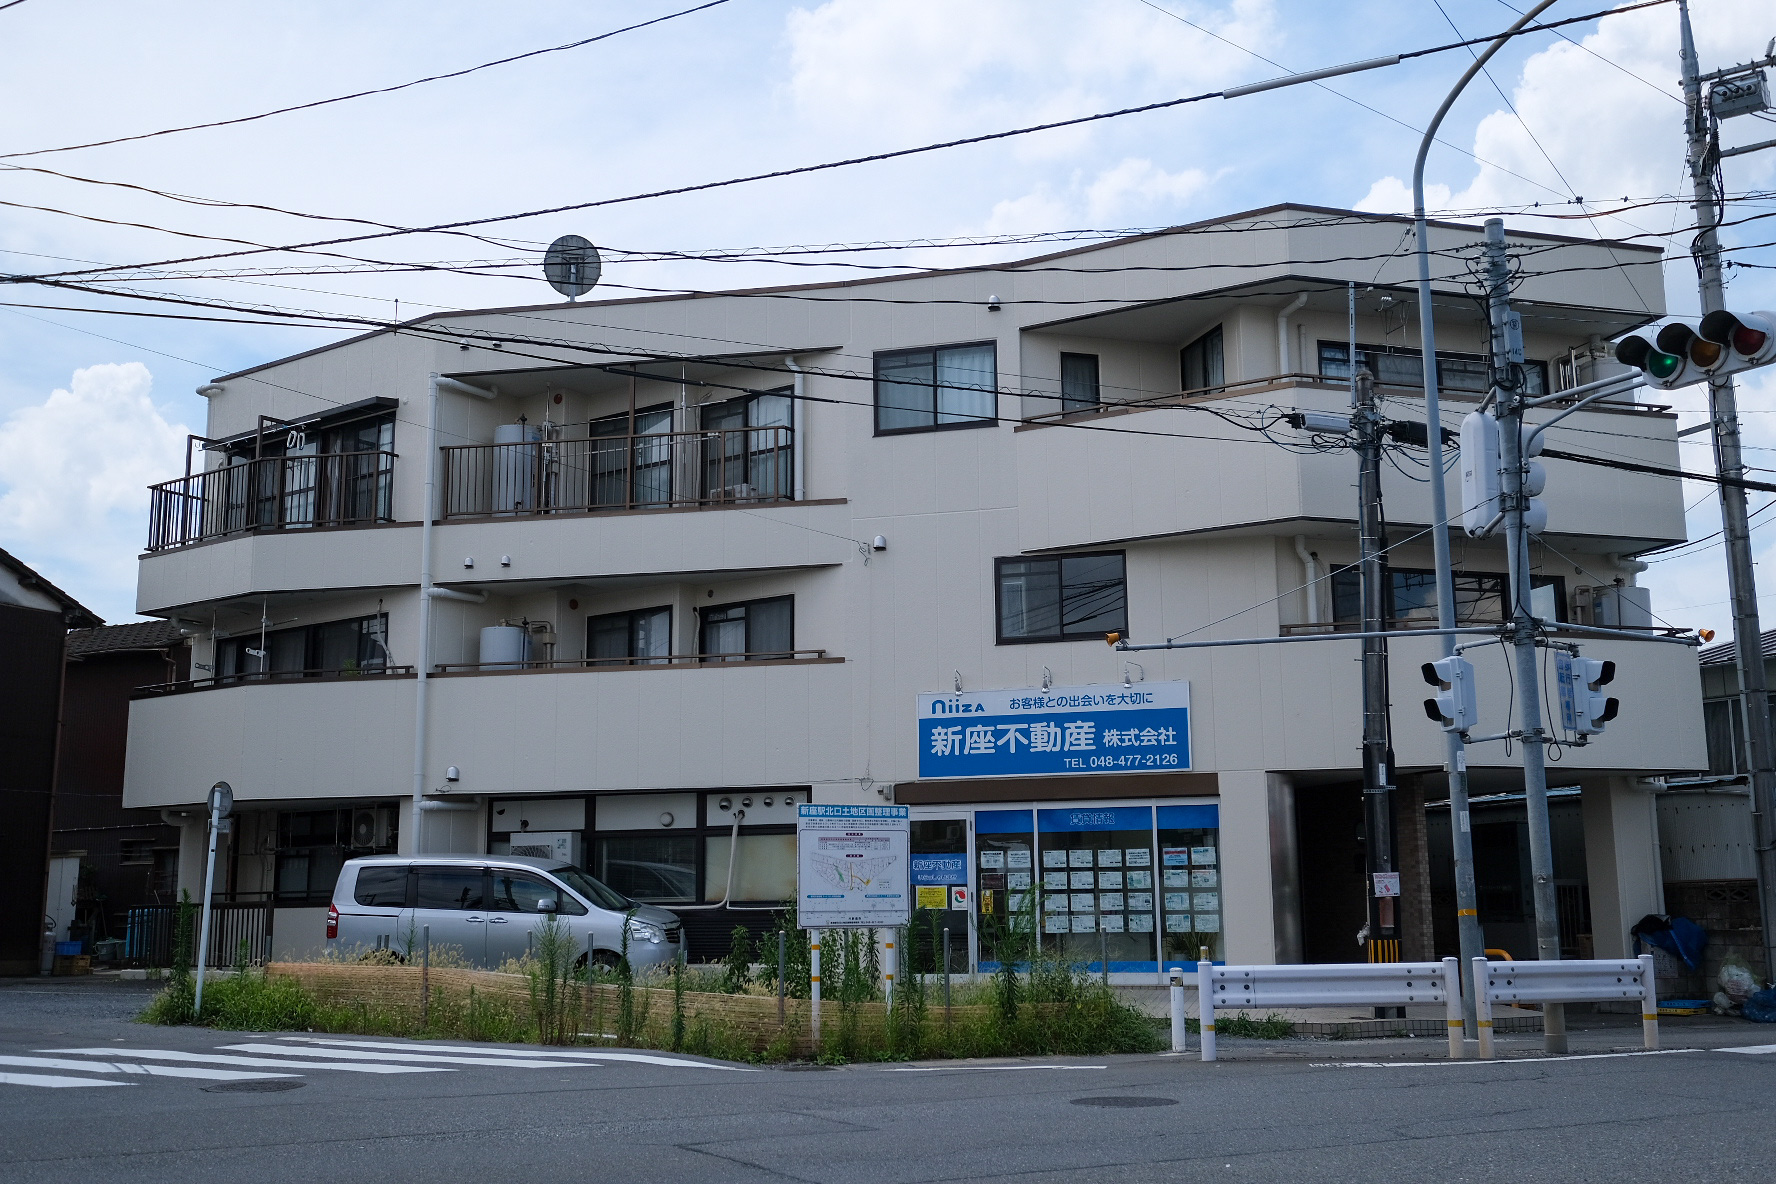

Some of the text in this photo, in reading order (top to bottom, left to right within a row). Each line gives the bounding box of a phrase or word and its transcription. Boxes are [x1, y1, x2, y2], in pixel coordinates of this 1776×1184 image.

[1009, 692, 1154, 710] お客様との出会いを大切に
[930, 720, 1177, 756] 新座不動産 株式会社
[1064, 754, 1178, 768] TEL 048-477-2126
[1070, 812, 1115, 825] 賃貸情報
[912, 859, 962, 871] 新座不動産
